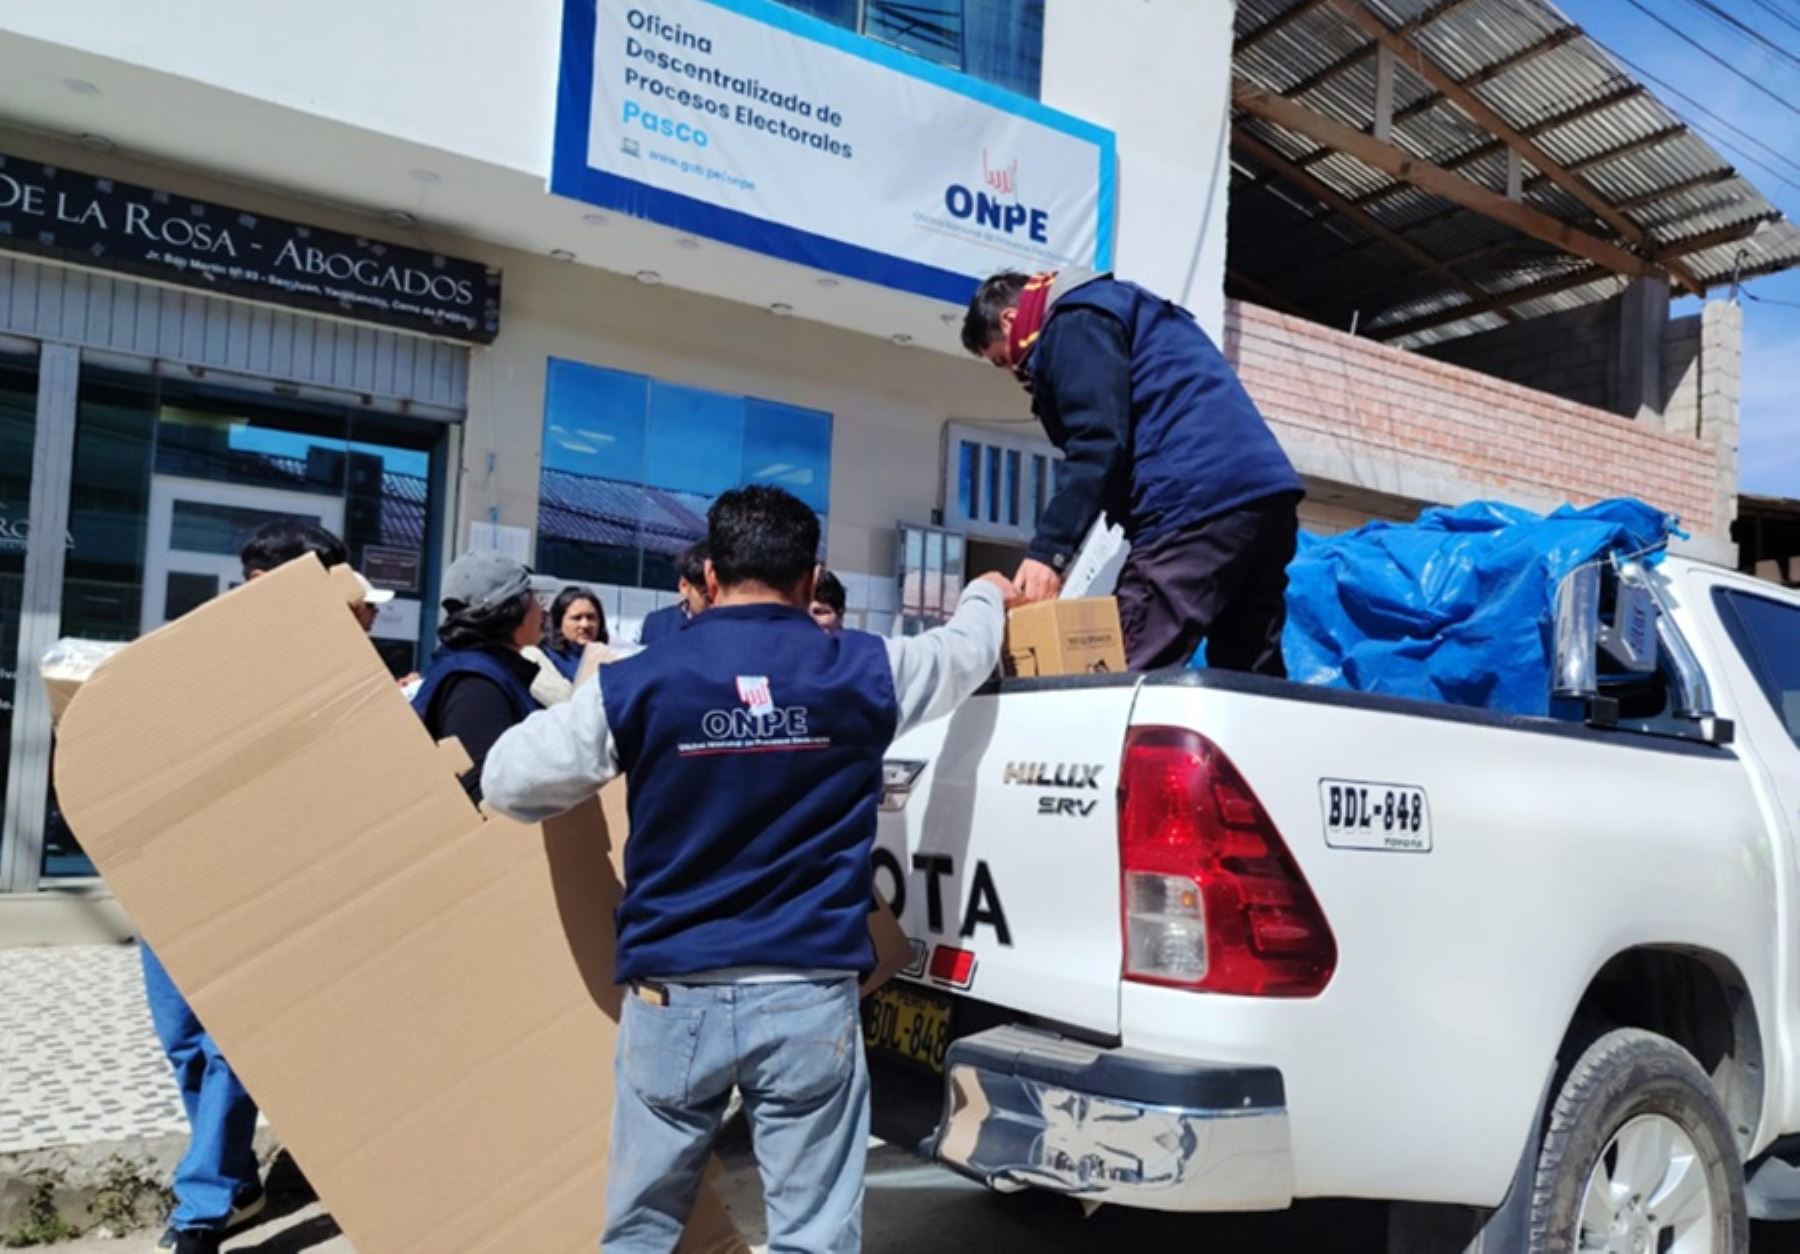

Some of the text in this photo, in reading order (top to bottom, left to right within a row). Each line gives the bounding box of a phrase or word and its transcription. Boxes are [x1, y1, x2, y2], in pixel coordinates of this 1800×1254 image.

[626, 9, 712, 54] Oficina
[626, 37, 842, 128] Descentralizada de
[623, 100, 708, 147] Pasco
[625, 67, 852, 160] Procesos Electorales
[945, 183, 1049, 244] ONPE
[57, 192, 109, 230] LA
[125, 203, 237, 257] ROSA
[274, 239, 473, 304] ABOGADOS
[702, 706, 808, 739] ONPE
[1003, 761, 1103, 790] HILUX
[1037, 797, 1097, 817] SRV
[1328, 786, 1422, 832] BDL-848
[870, 847, 1014, 948] OTA
